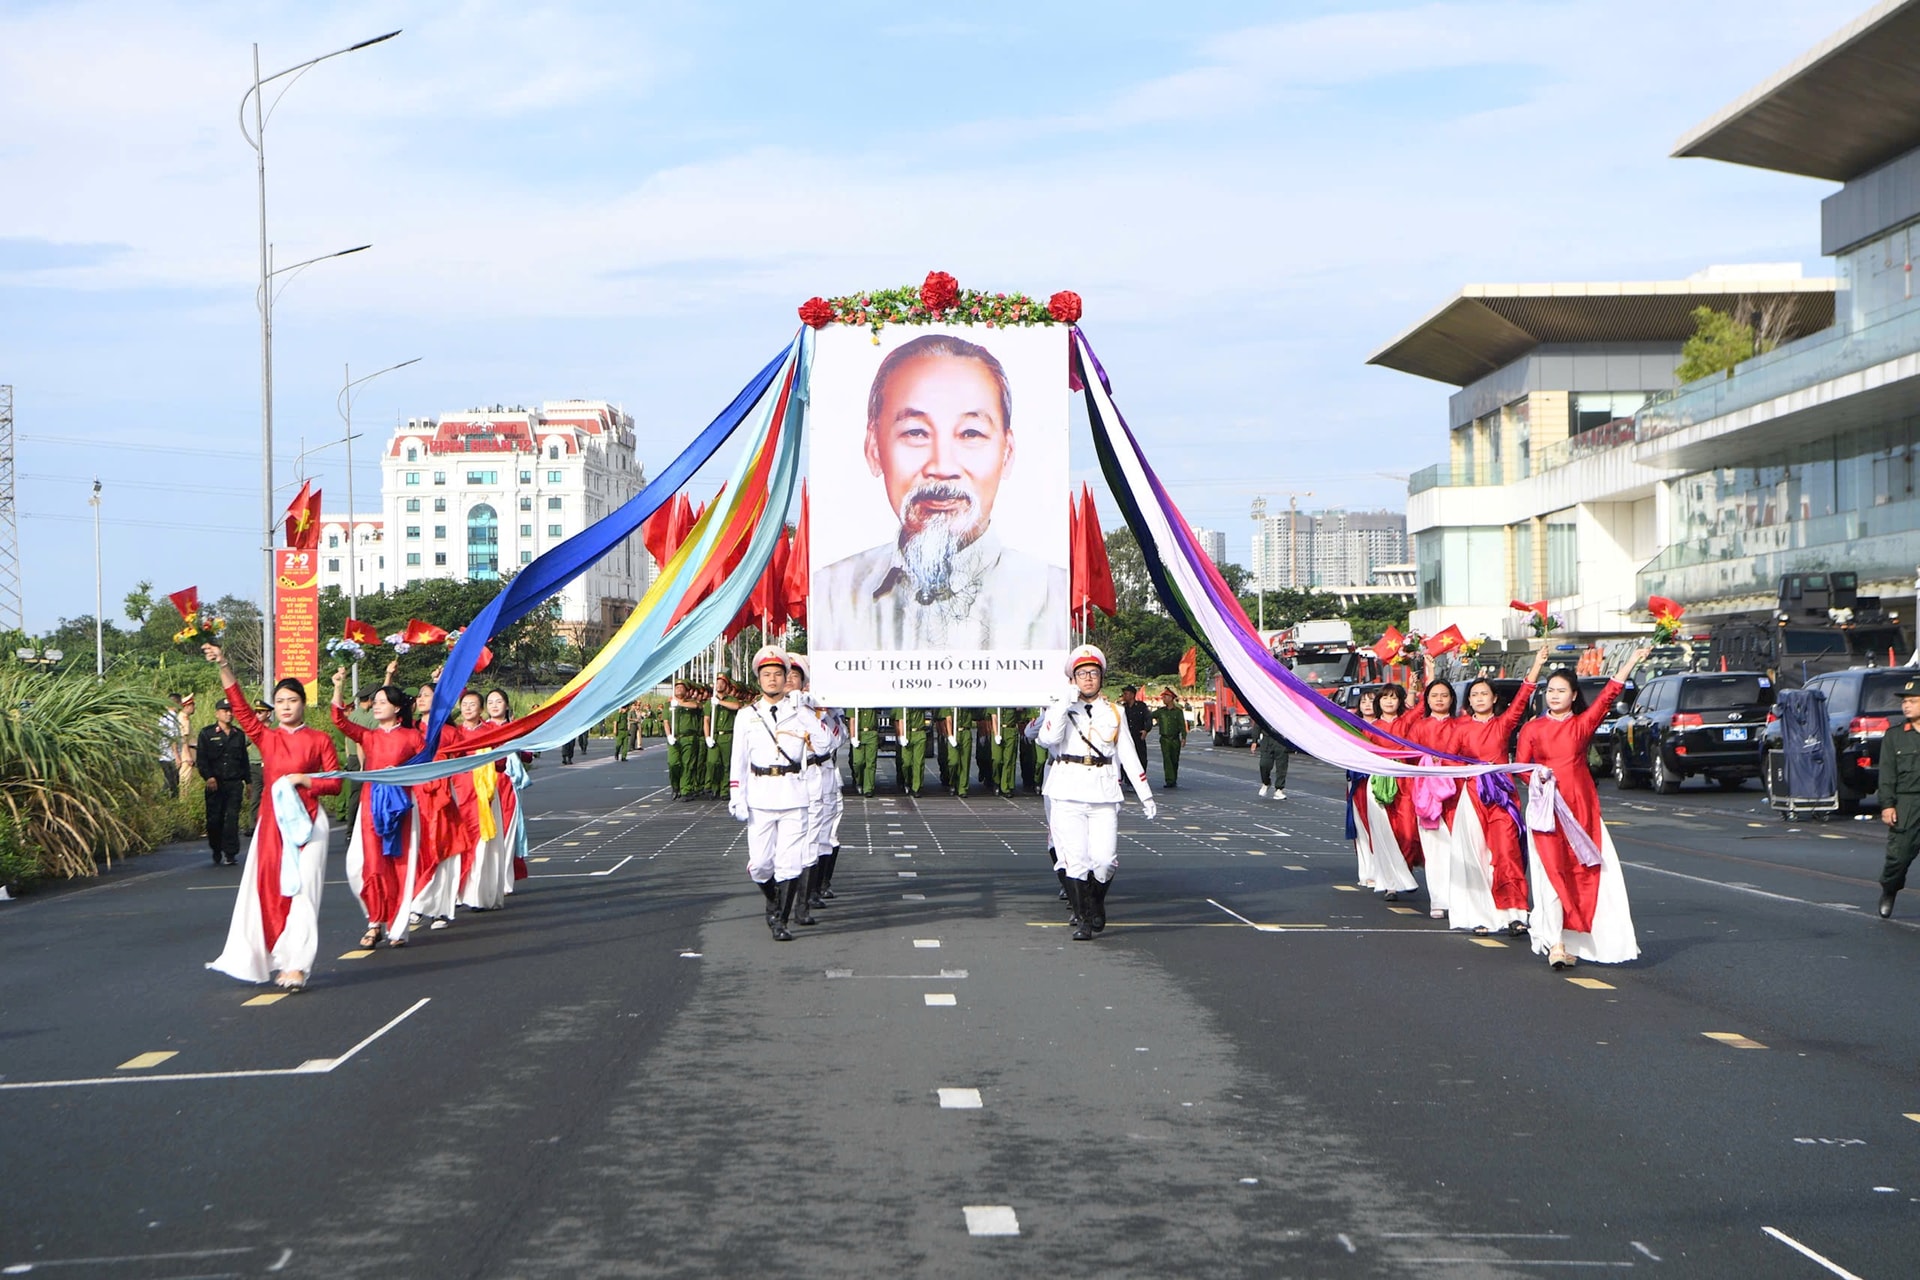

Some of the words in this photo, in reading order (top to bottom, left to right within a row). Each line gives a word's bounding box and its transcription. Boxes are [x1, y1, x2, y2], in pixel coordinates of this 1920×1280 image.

[834, 656, 872, 671] CHỦ
[878, 660, 921, 674] TỊCH
[927, 655, 953, 670] HỒ
[958, 656, 990, 670] CHÍ
[996, 659, 1044, 670] MINH
[892, 678, 932, 690] (1890
[948, 678, 987, 690] 1969)
